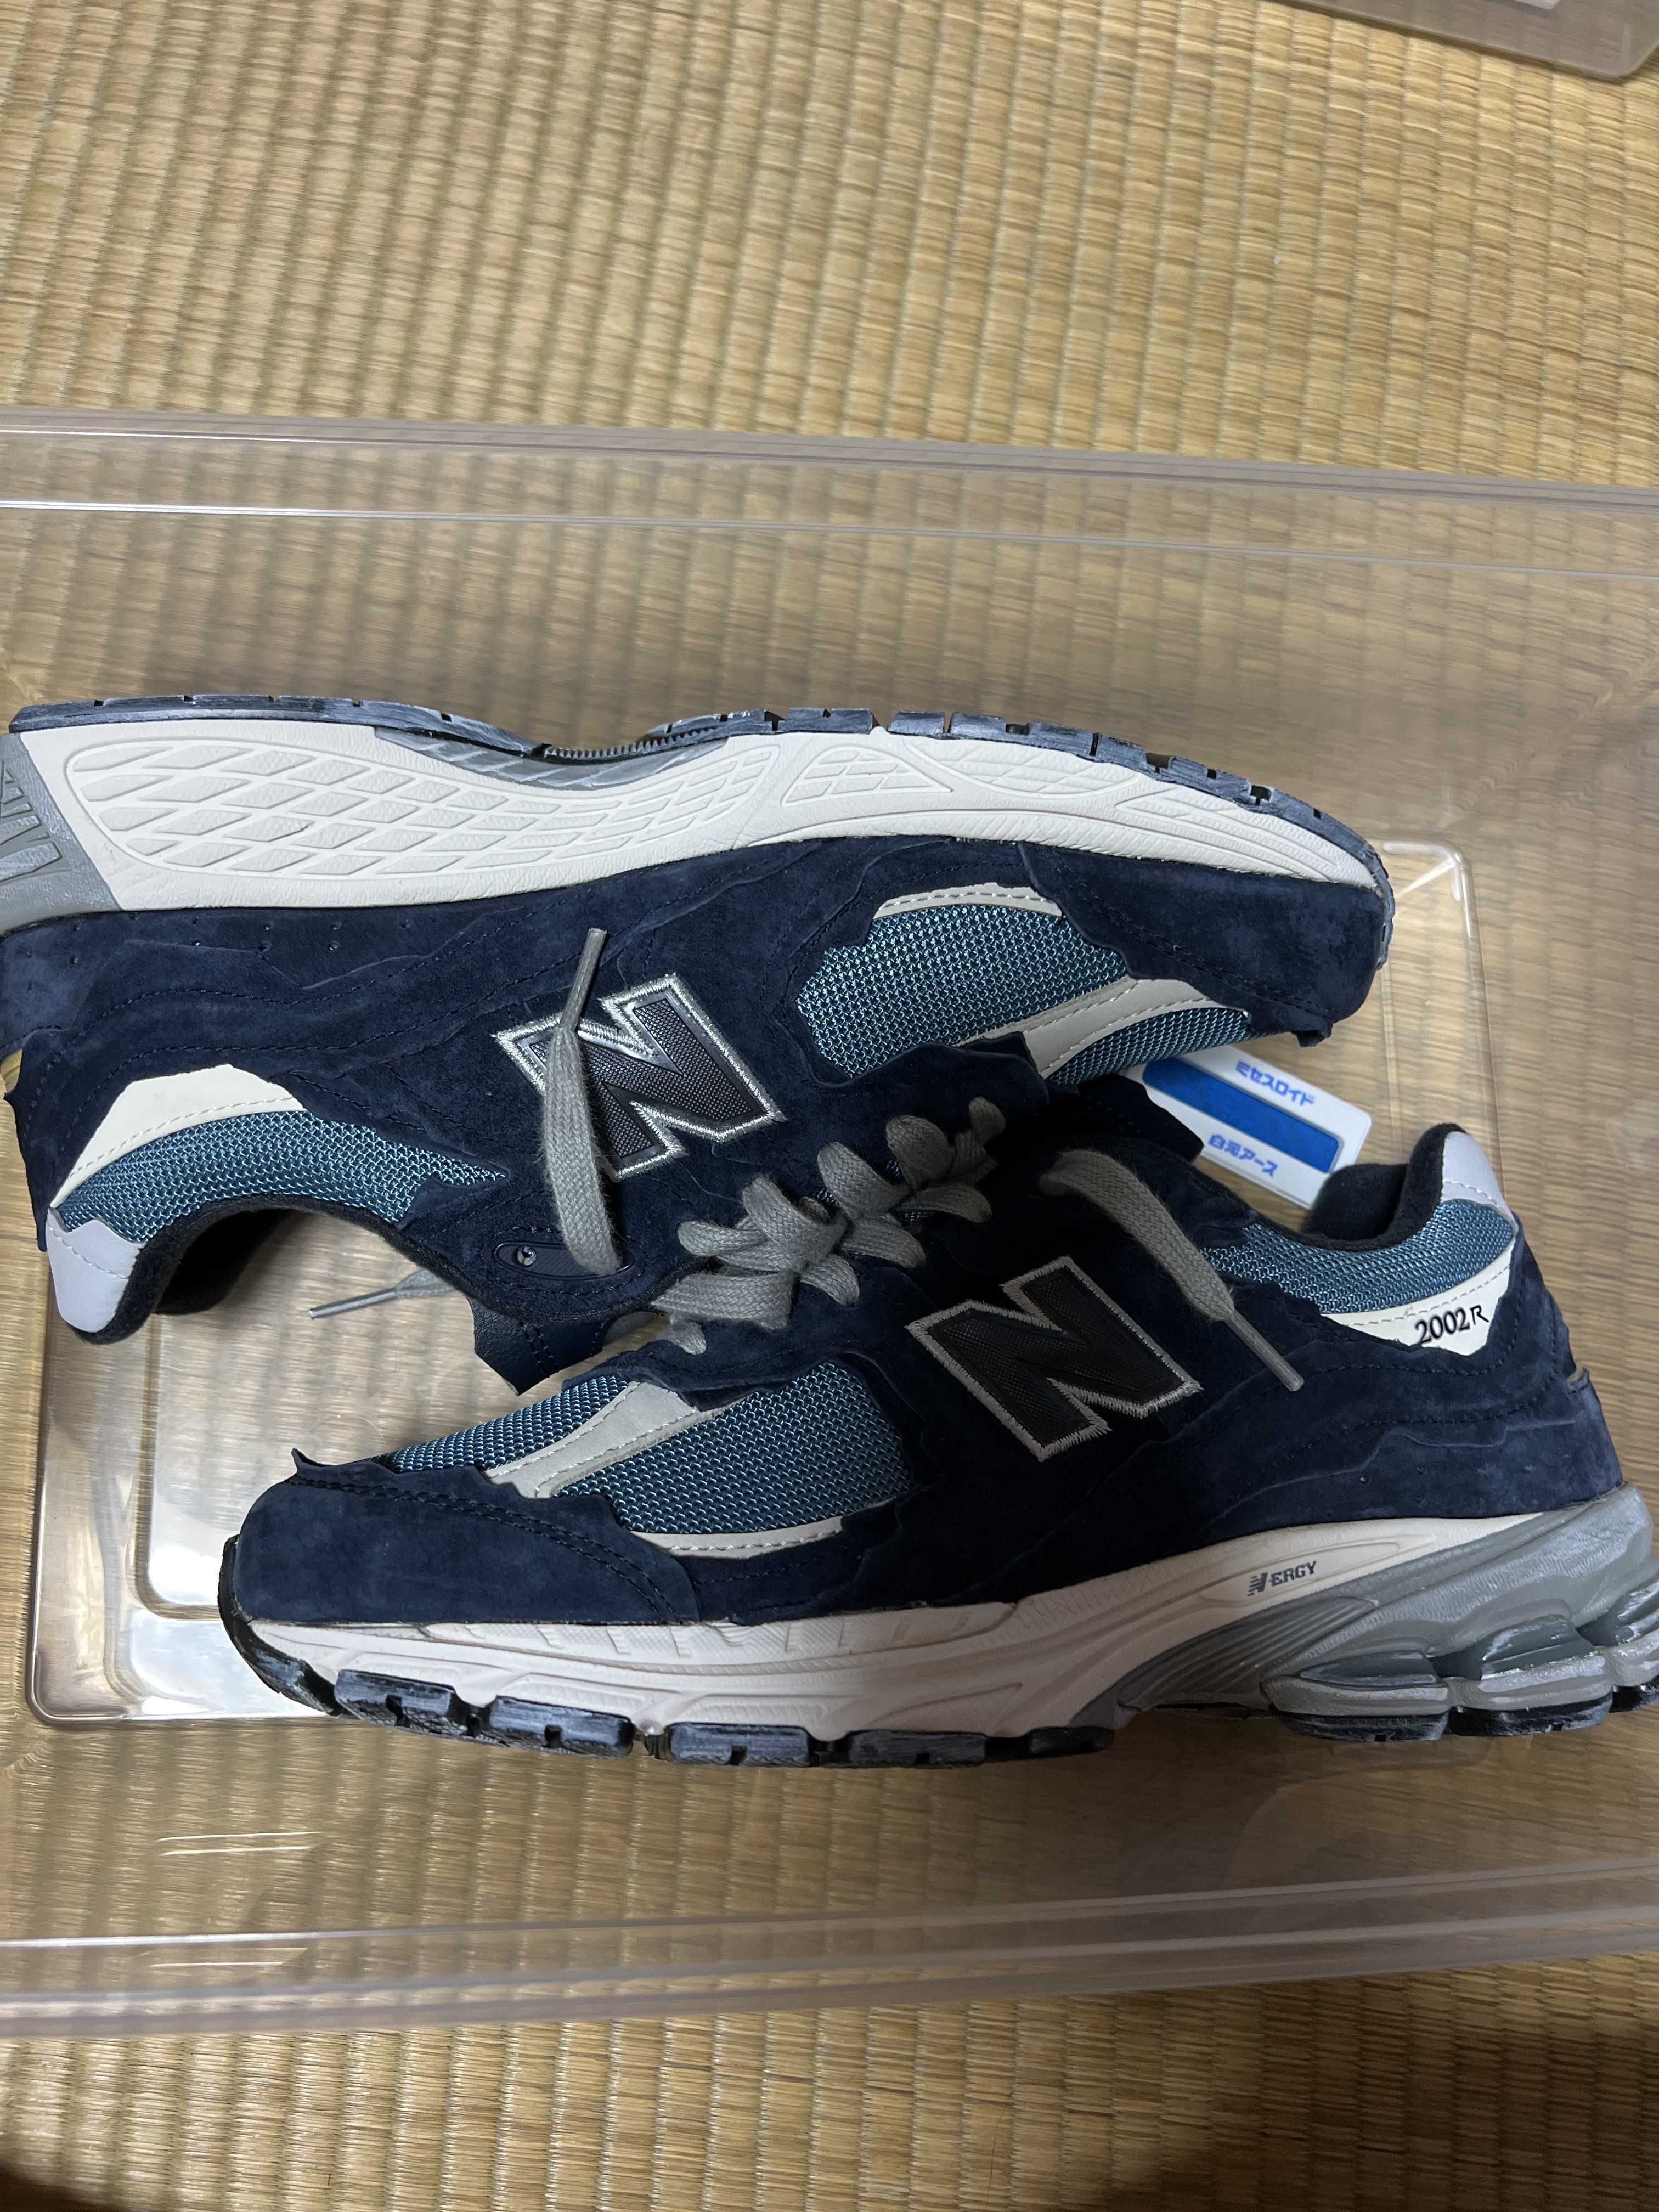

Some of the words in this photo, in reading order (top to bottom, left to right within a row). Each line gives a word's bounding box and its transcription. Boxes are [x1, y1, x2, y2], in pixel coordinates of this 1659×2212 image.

[1235, 1060, 1315, 1107] ミセスロイド
[1208, 1133, 1279, 1178] 白元アース
[904, 1256, 1204, 1462] N
